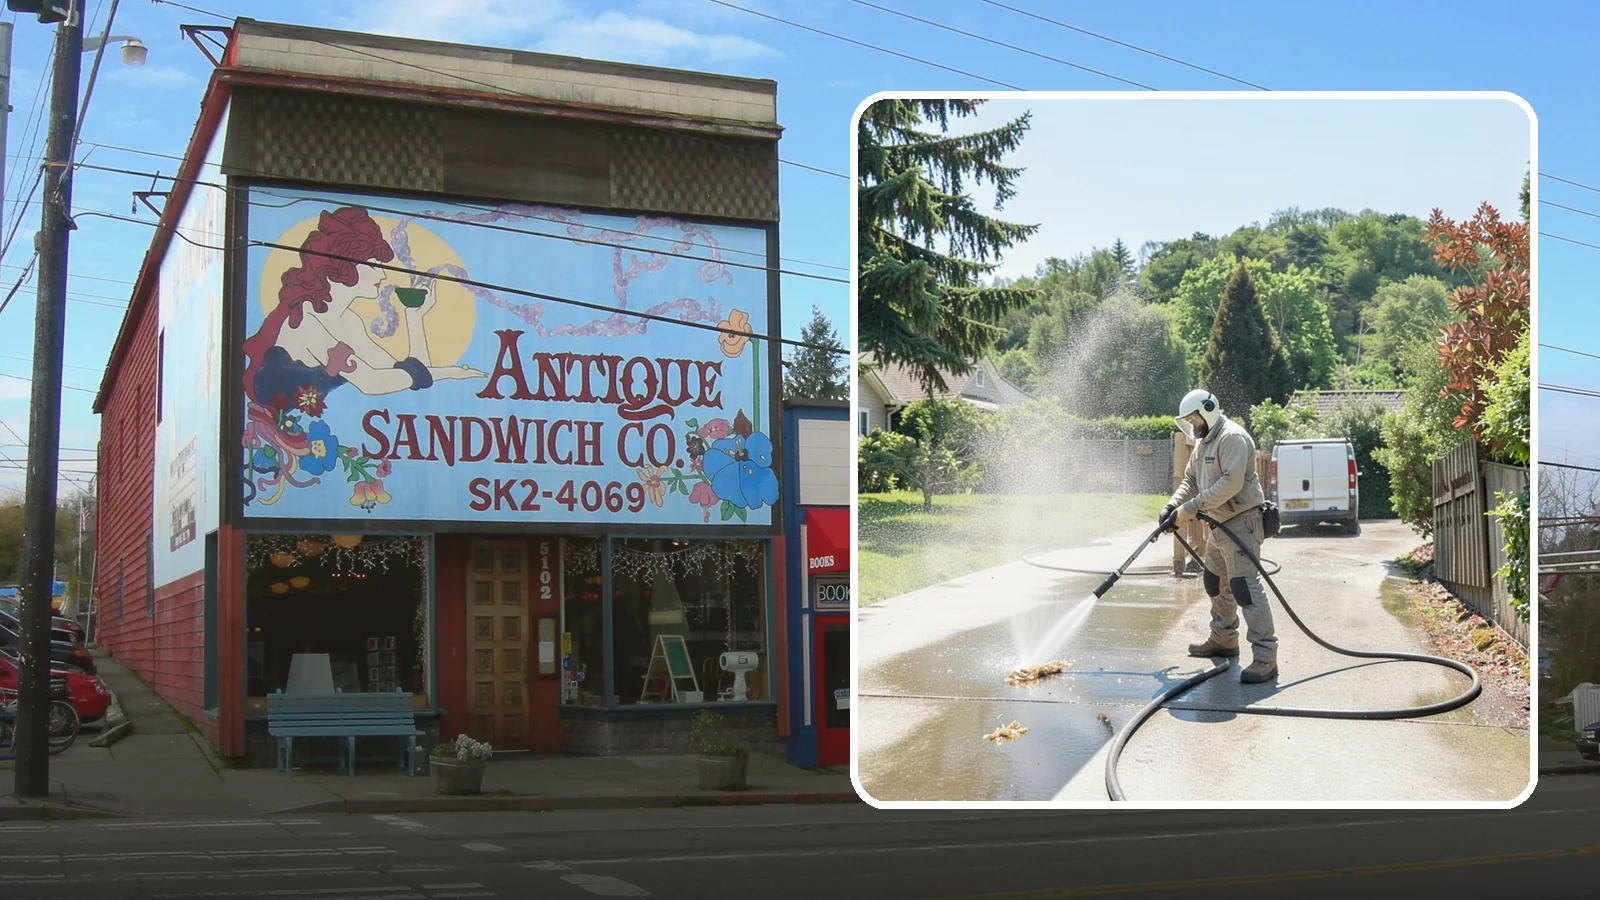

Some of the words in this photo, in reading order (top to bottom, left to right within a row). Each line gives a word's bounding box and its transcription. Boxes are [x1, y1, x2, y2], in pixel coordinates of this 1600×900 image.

[476, 329, 723, 421] ANTIQUE
[361, 409, 604, 466] SANDWICH
[617, 422, 685, 469] CO.
[469, 477, 645, 513] SK2-4069
[540, 541, 551, 599] 5102
[809, 555, 835, 568] BOOKS
